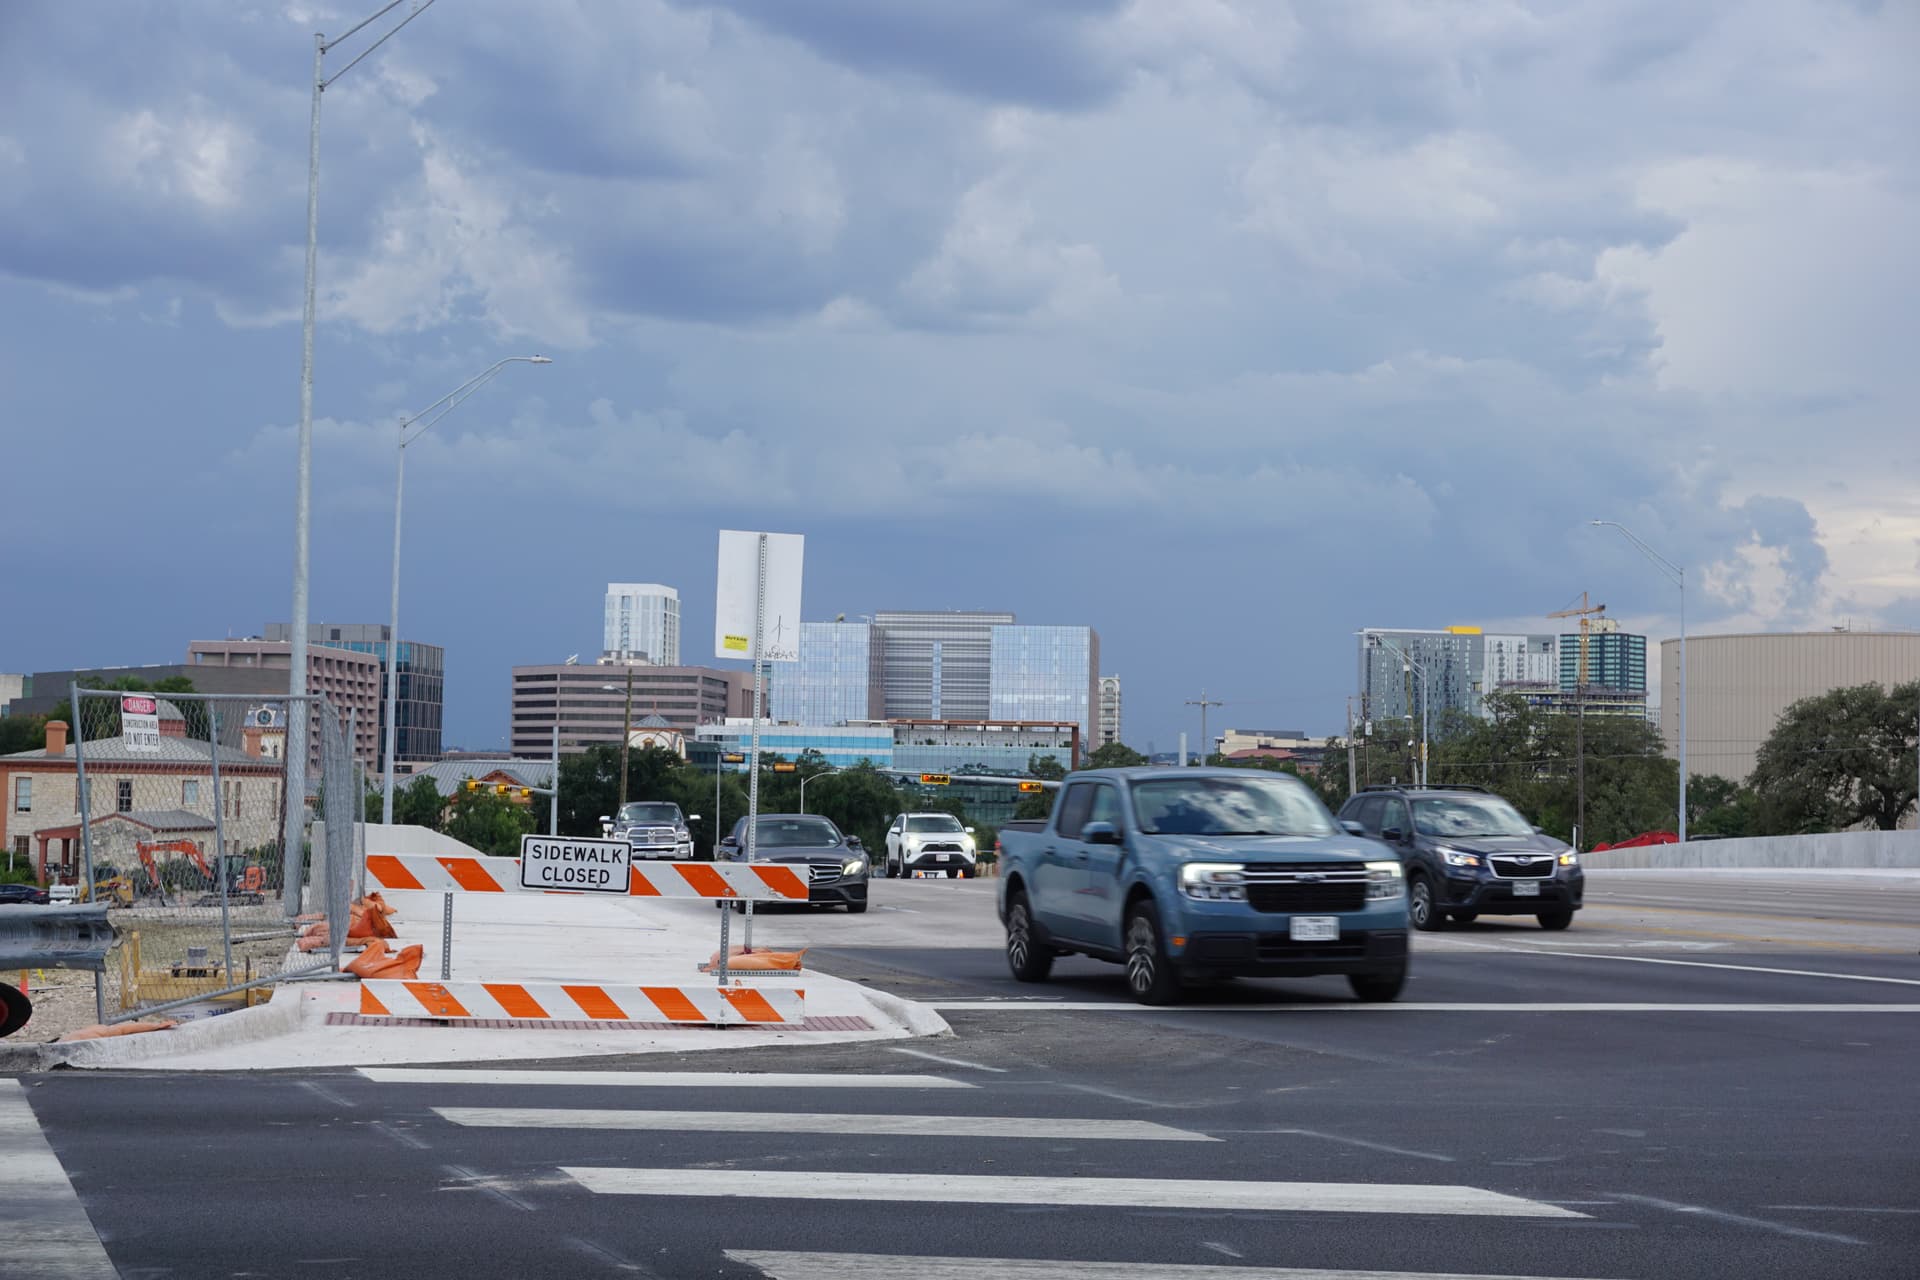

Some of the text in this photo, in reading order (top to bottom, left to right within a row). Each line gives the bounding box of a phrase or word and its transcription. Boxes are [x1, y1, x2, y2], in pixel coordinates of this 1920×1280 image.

[128, 698, 151, 713] DANGER
[124, 719, 158, 729] CONSTRUCTION AREA
[124, 731, 159, 746] DO NOT ENTER
[532, 844, 622, 864] SIDEWALK
[542, 866, 610, 884] CLOSED
